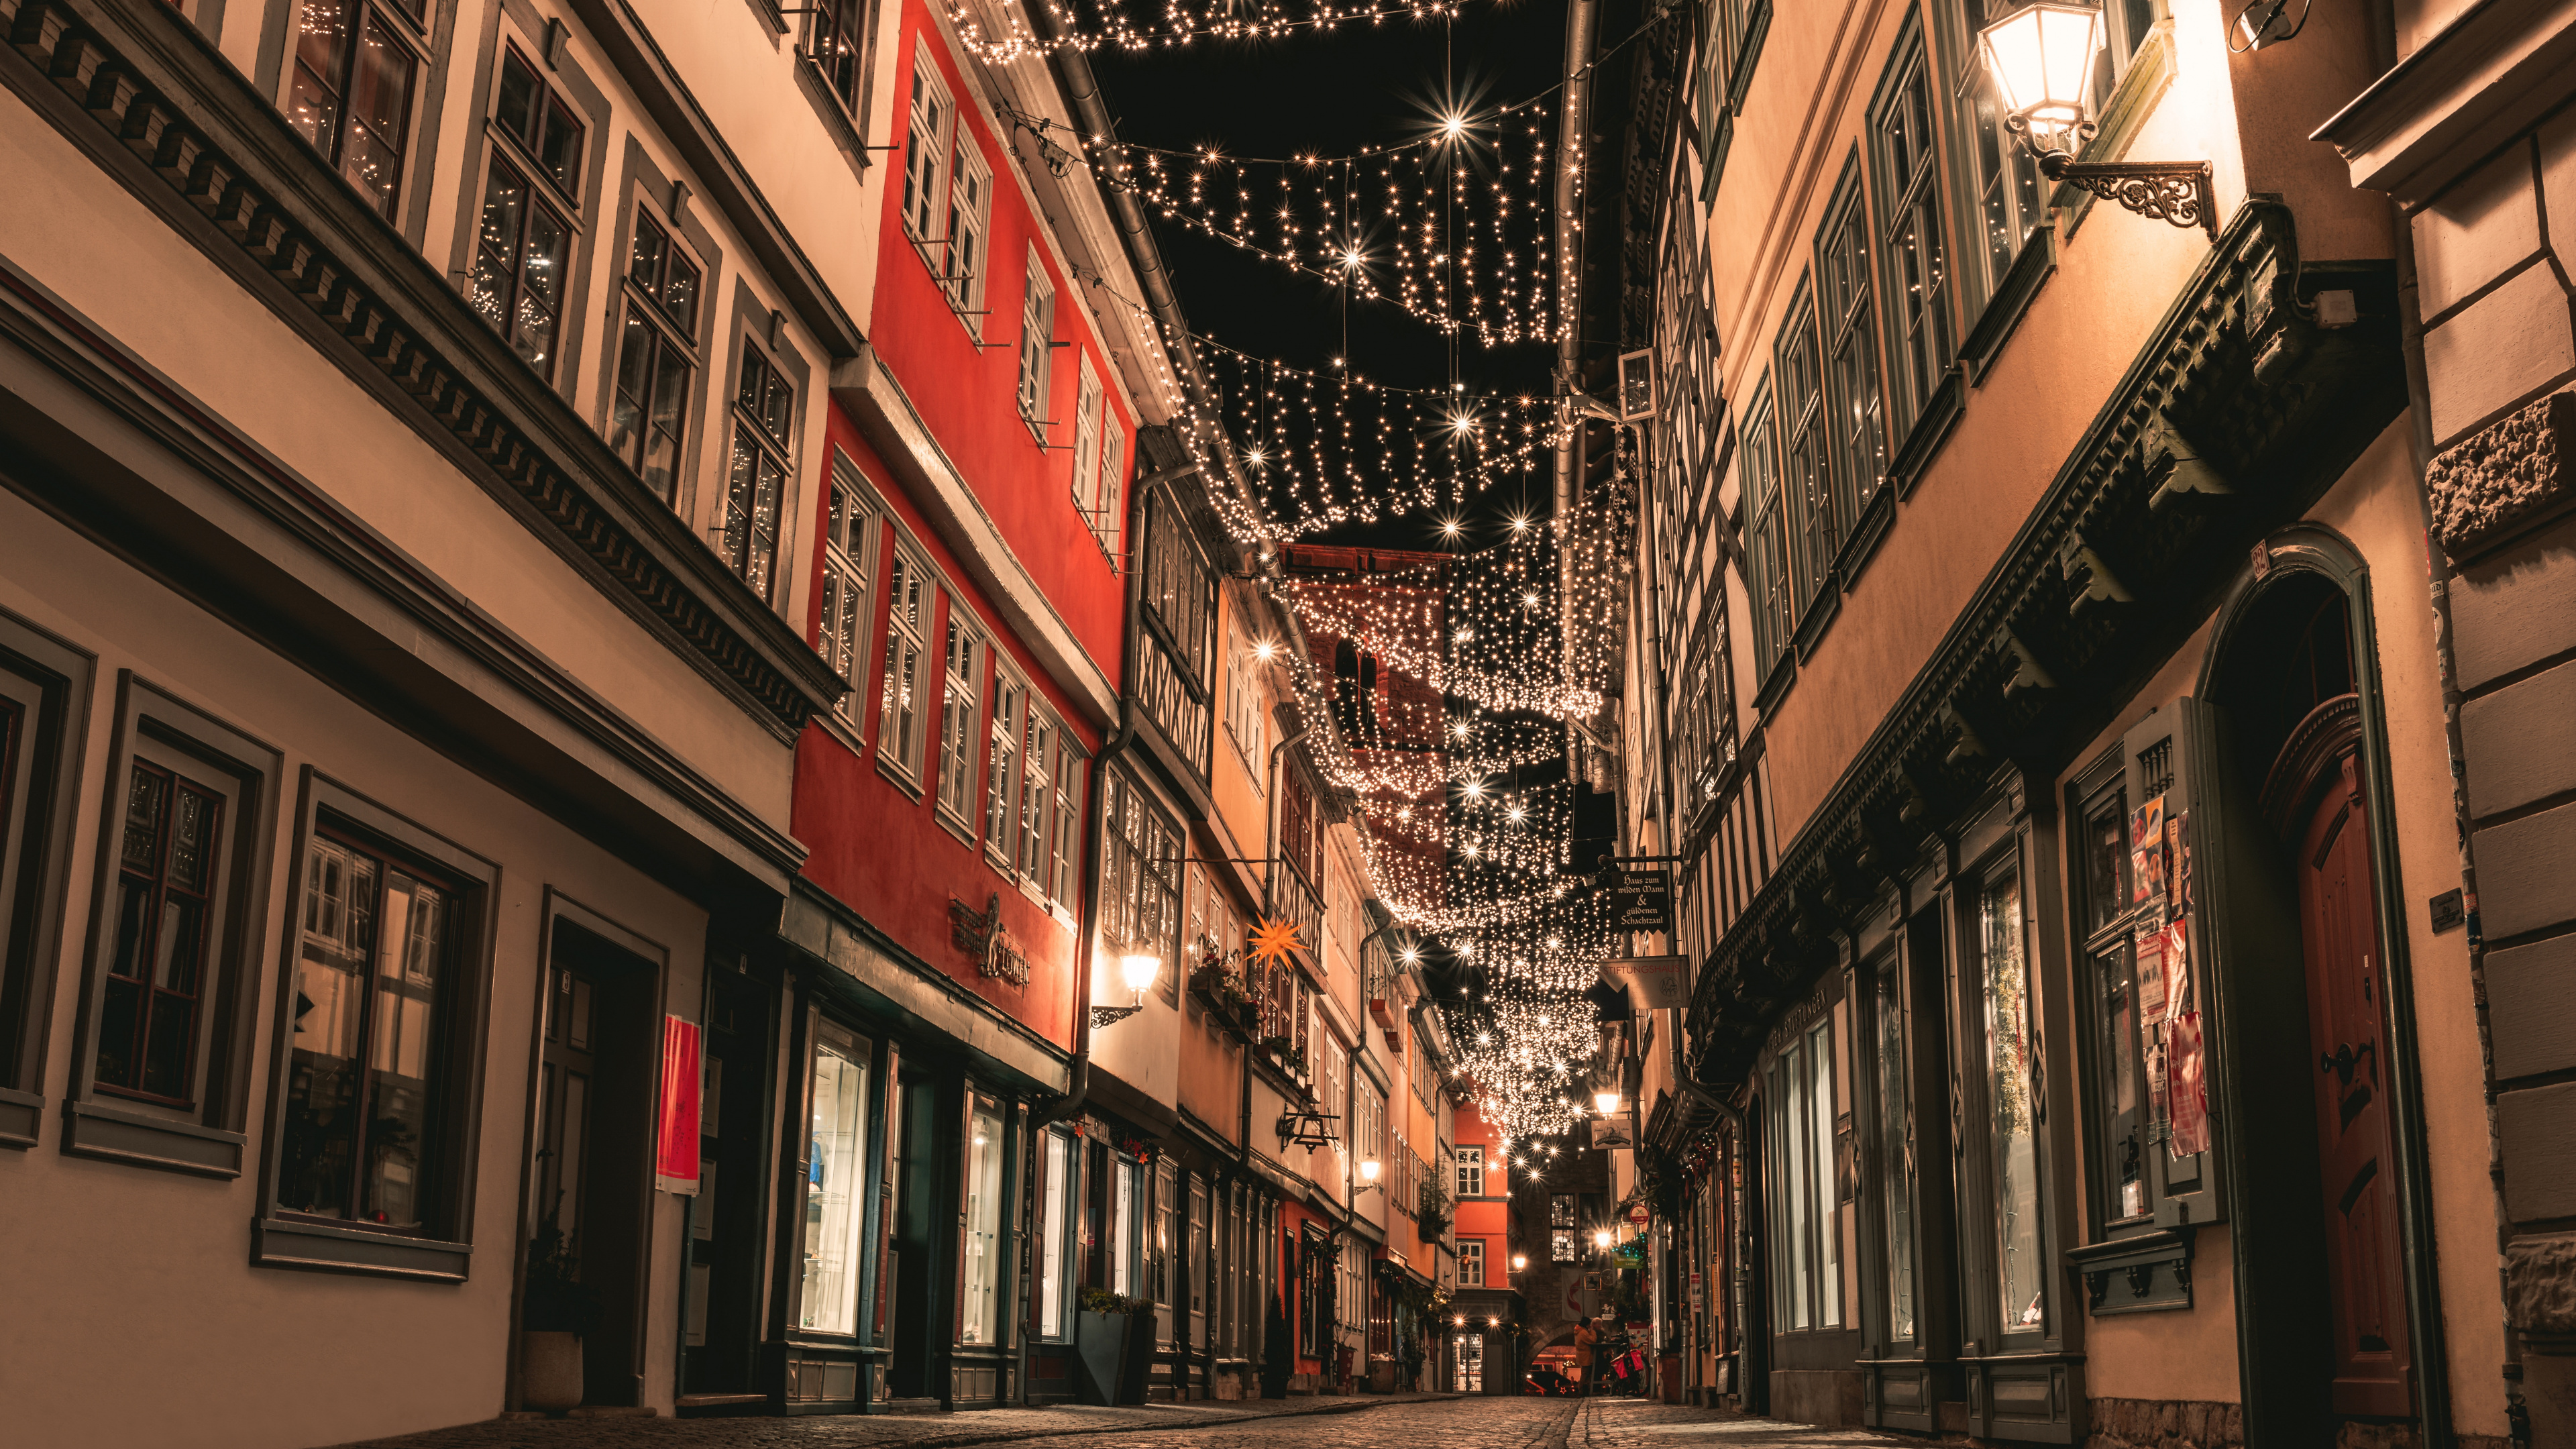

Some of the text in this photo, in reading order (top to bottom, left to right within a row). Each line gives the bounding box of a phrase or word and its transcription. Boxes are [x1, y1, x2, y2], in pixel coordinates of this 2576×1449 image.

[1623, 875, 1643, 885] Haus
[1618, 885, 1641, 893] wilden
[1637, 894, 1647, 906] &
[1626, 907, 1658, 916] güldenen
[1603, 964, 1680, 975] STIFTUNGSHAUS
[565, 974, 569, 989] 3
[1784, 987, 1826, 1038] STIFTUNGEN
